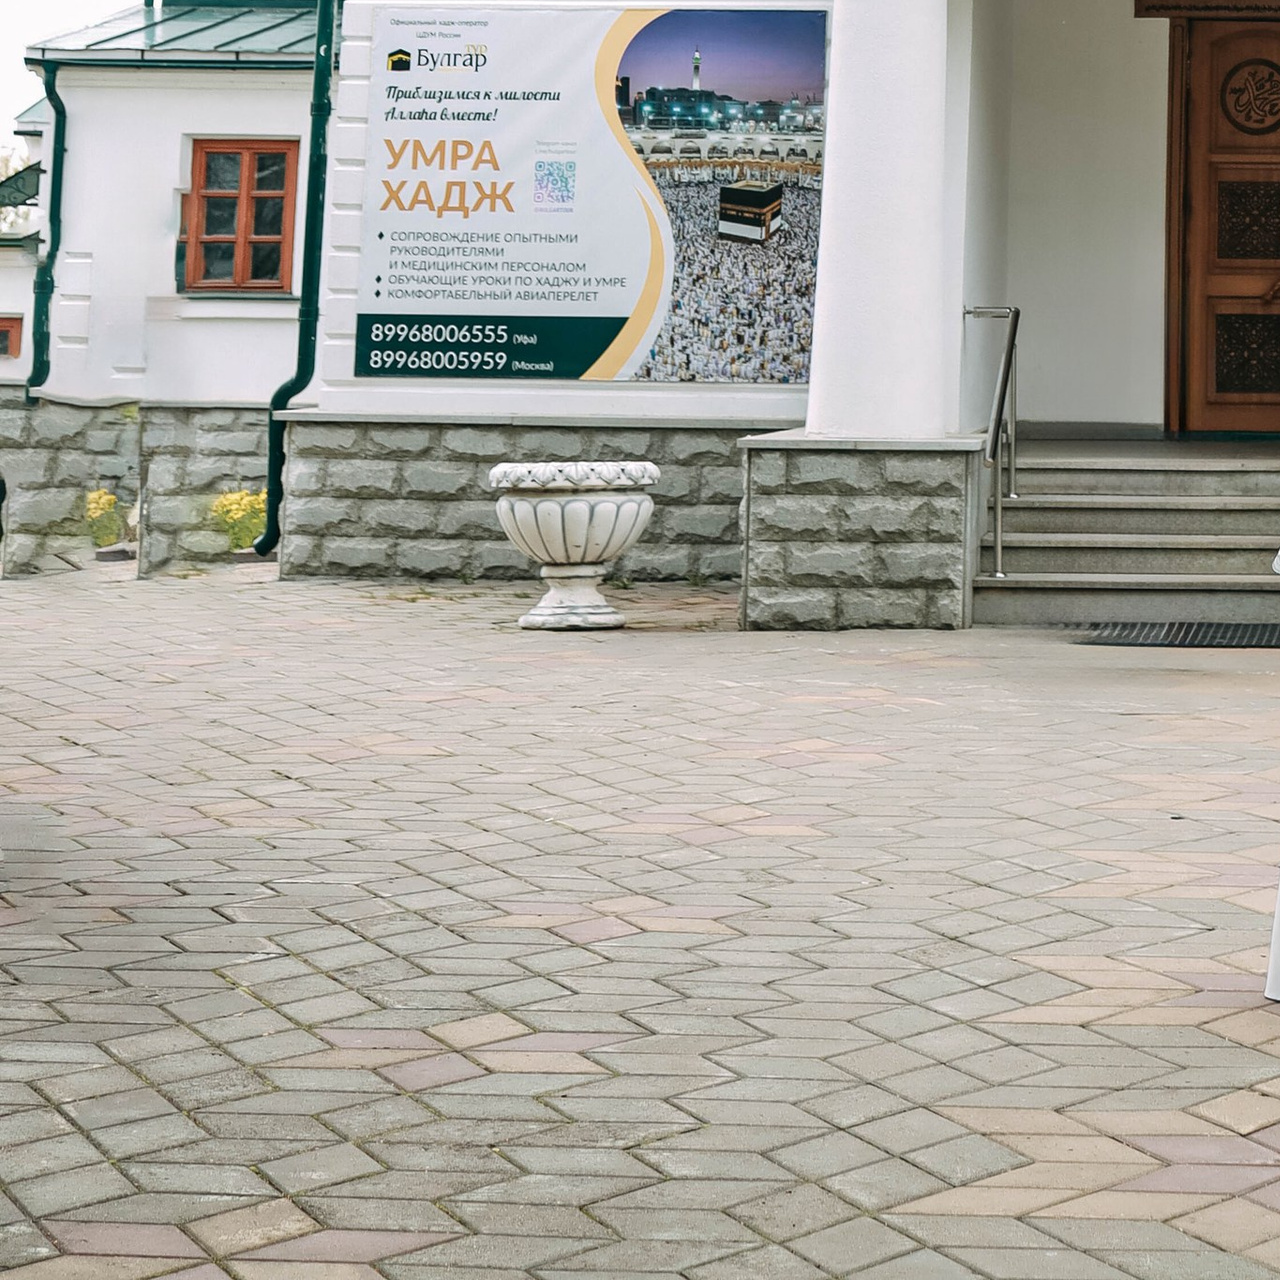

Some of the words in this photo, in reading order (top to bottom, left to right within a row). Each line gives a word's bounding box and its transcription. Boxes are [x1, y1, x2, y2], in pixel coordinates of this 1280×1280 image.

[417, 48, 488, 72] Булгар
[386, 86, 480, 103] Приблизимся
[483, 91, 492, 101] к
[495, 90, 561, 101] милости
[440, 107, 498, 122] вместе!
[383, 139, 500, 171] УМРА
[379, 180, 516, 219] ХАДЖ
[390, 231, 501, 244] СОПРОВОЖДЕНИЕ
[504, 232, 579, 244] ОПЫТНЫМИ
[390, 246, 505, 258] РУКОВОДИТЕЛЯМИ
[389, 260, 398, 270] И
[401, 260, 499, 272] МЕДИЦИНСКИМ
[501, 261, 587, 272] ПЕРСОНАЛОМ
[388, 274, 468, 287] ОБУЧАЮЩИЕ
[471, 275, 511, 286] УРОКИ
[514, 276, 532, 286] ПО
[535, 277, 580, 288] ХАДЖУ
[582, 278, 591, 287] И
[594, 278, 627, 288] УМРЕ
[387, 289, 512, 301] КОМФОРТАБЕЛЬНЫЙ
[515, 290, 599, 302] АВИАПЕРЕЛЕТ
[370, 323, 508, 343] 89968006555
[512, 334, 537, 345] (Уфа)
[369, 350, 507, 370] 89968005959
[511, 360, 554, 371] (Москва)
